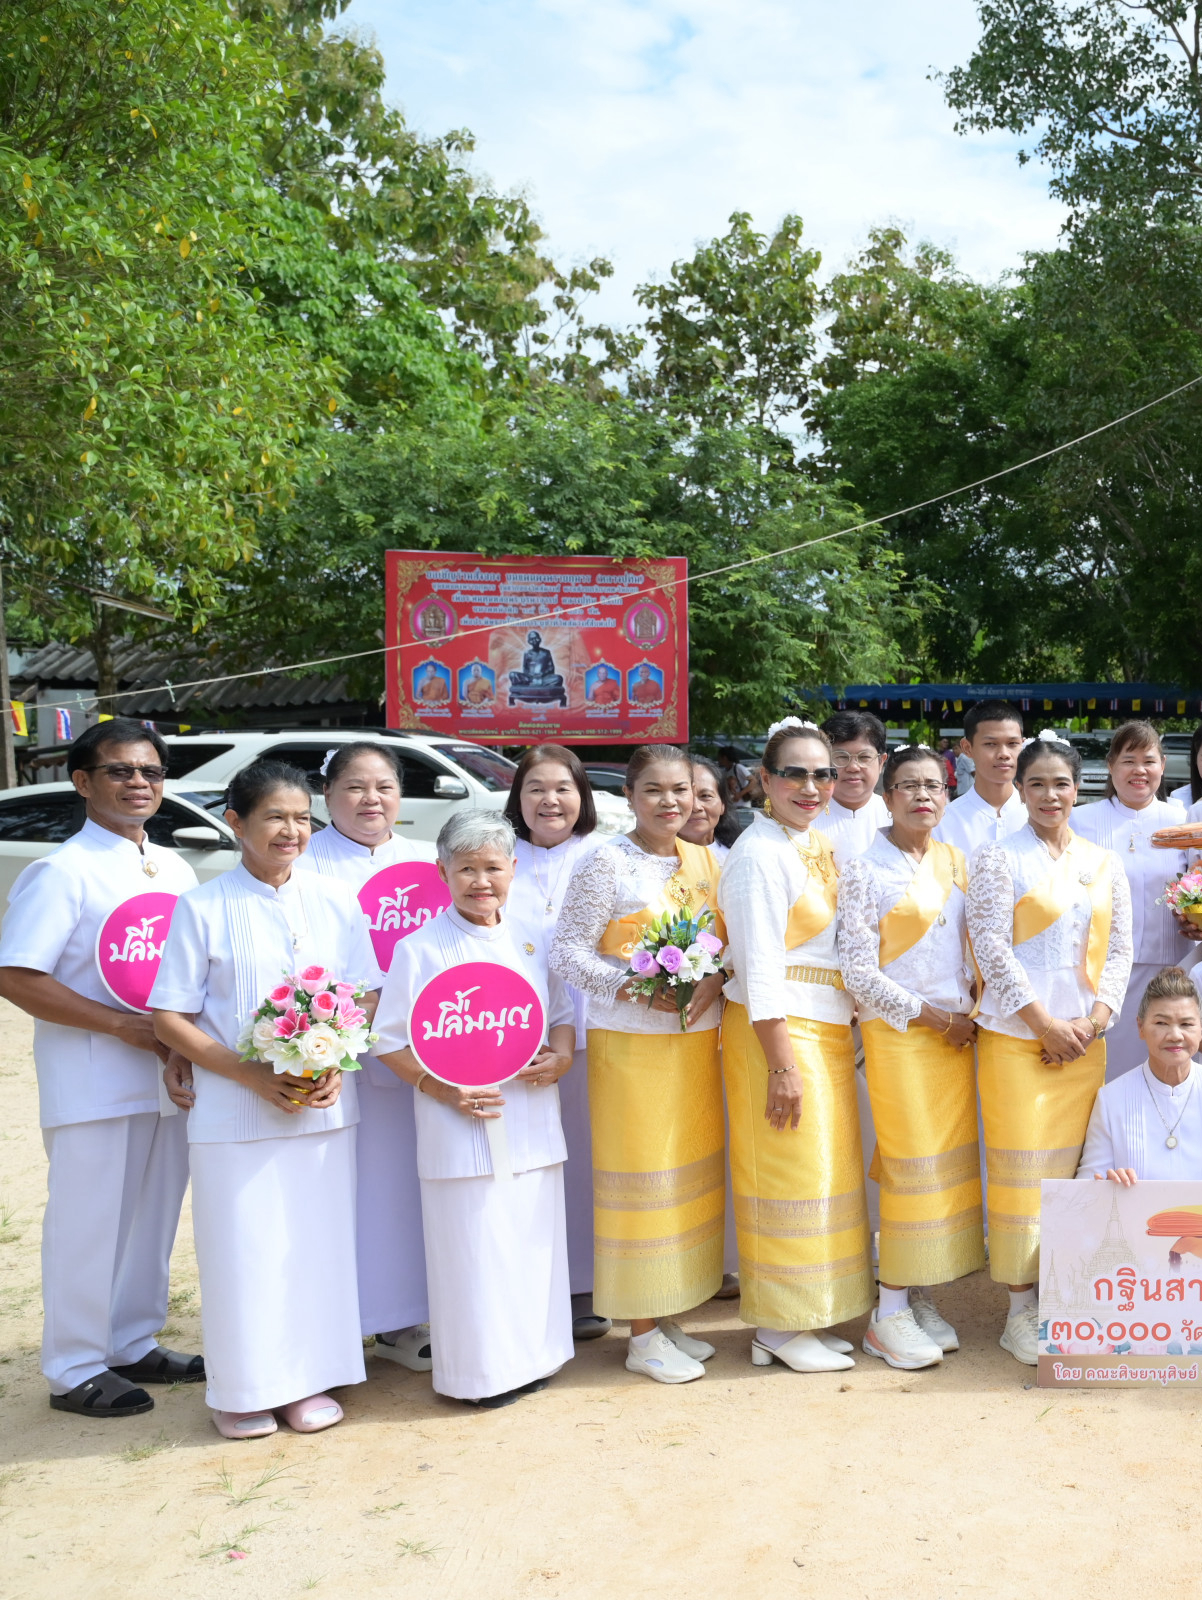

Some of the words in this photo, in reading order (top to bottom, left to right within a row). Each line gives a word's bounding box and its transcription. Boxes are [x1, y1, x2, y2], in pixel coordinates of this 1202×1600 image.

[422, 986, 533, 1047] ปลื้มบุญ
[1051, 1320, 1172, 1346] ๓๐,๐๐๐
[1055, 1364, 1081, 1379] โดย
[1086, 1363, 1197, 1384] คณะศิษยานุศิษย์
